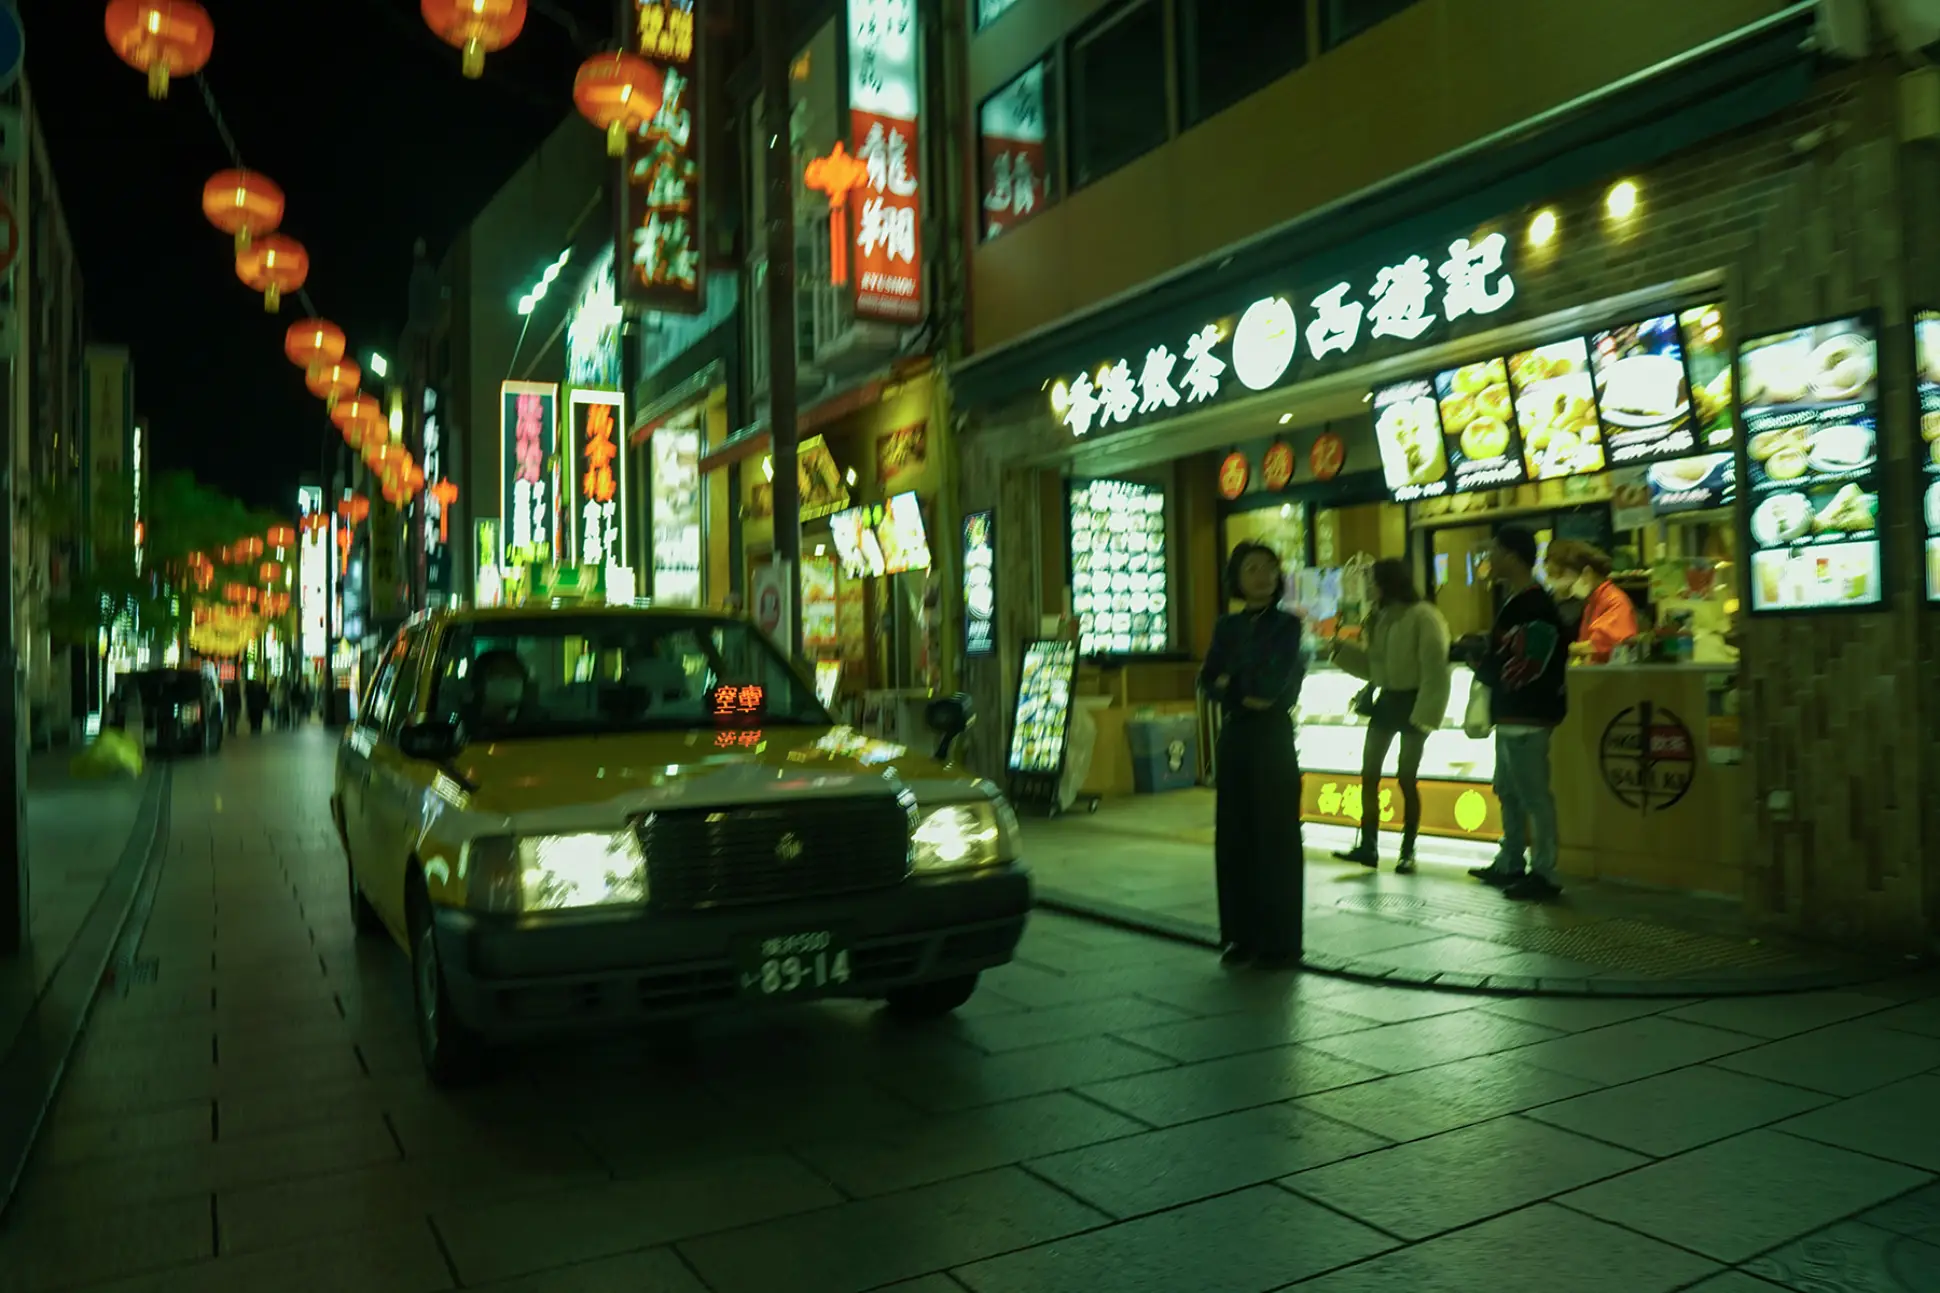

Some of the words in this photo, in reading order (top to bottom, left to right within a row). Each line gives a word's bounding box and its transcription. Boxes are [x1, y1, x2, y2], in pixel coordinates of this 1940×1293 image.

[1063, 323, 1228, 436] 香港飲茶
[1305, 233, 1515, 361] 西遊記
